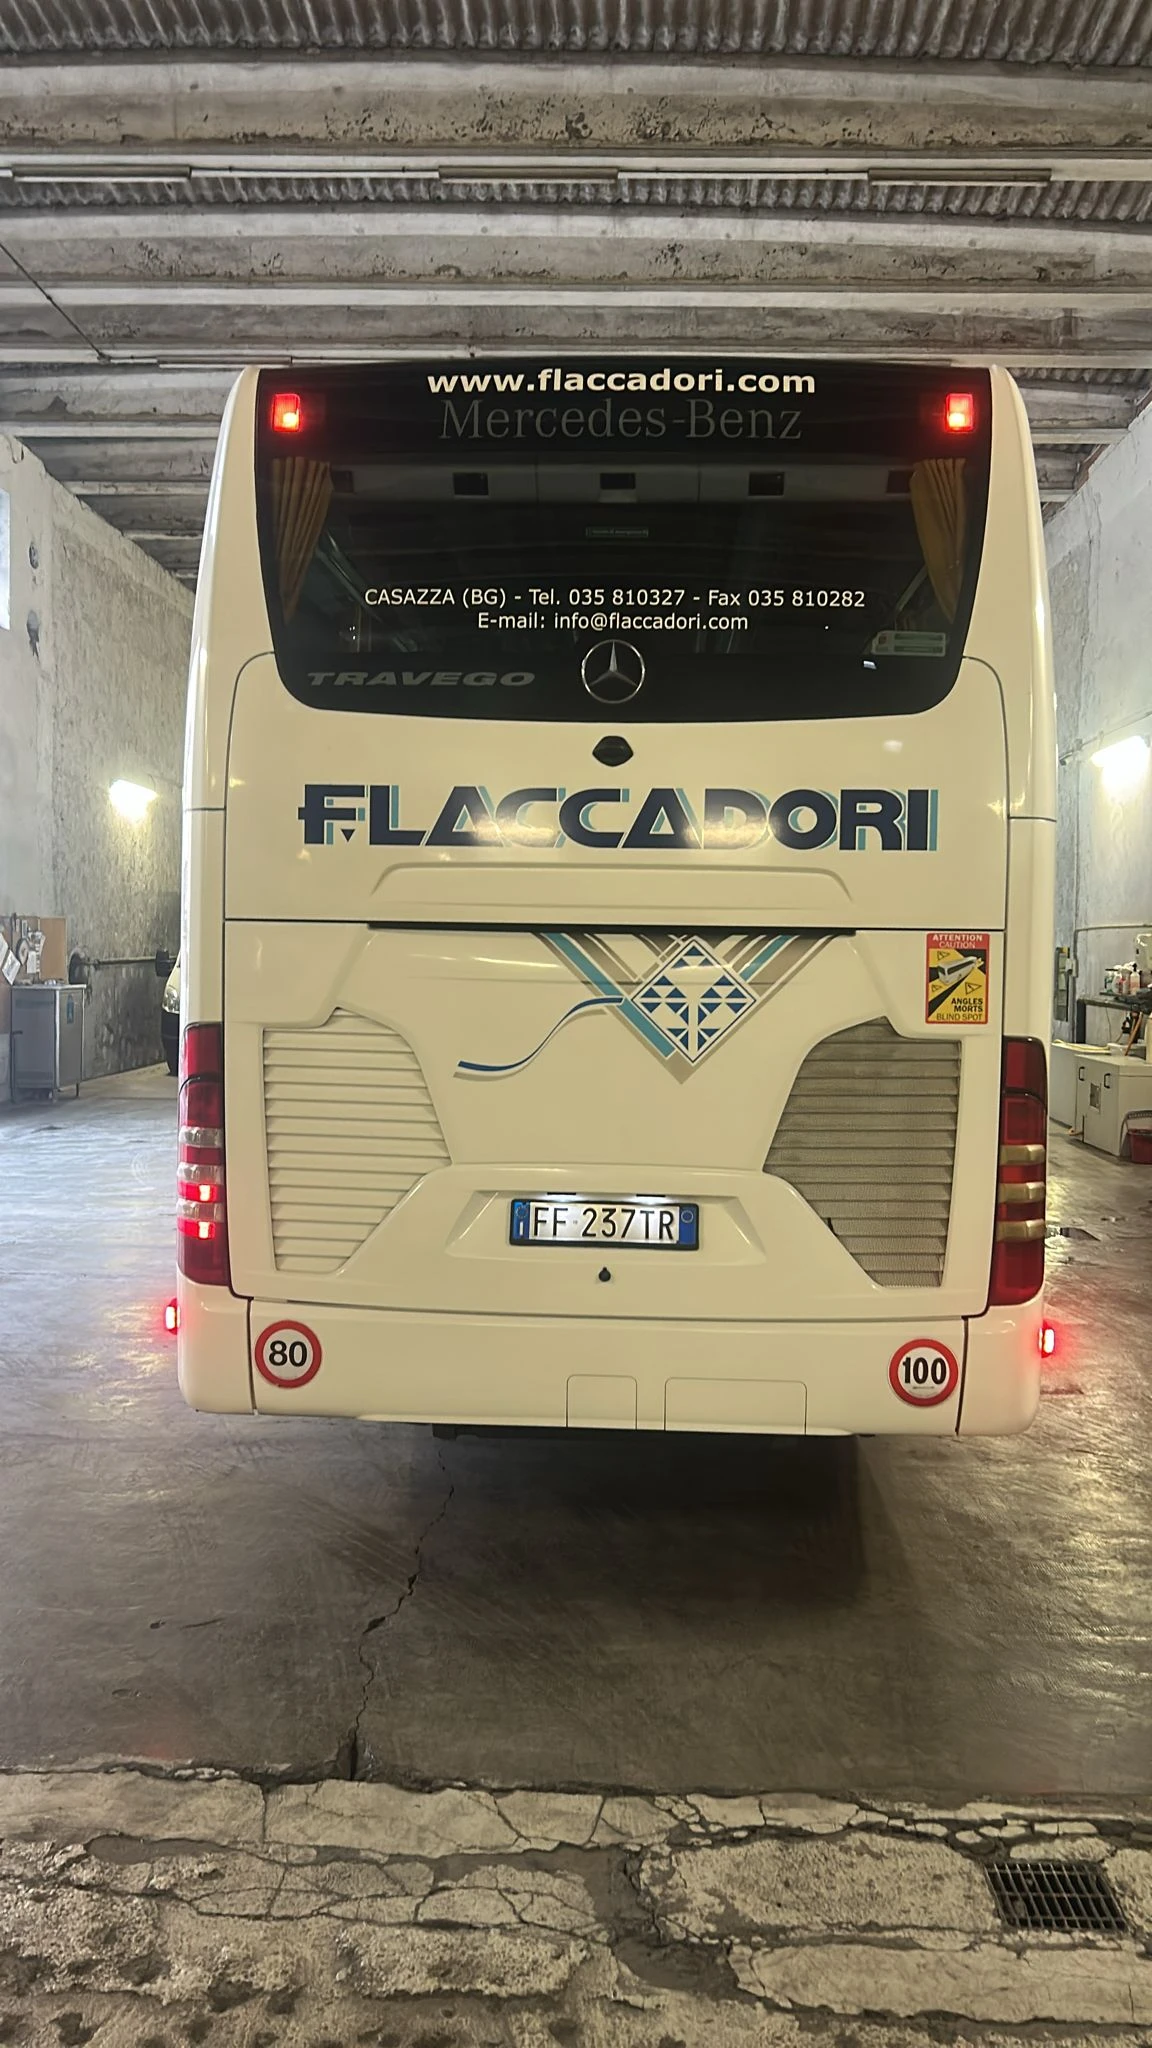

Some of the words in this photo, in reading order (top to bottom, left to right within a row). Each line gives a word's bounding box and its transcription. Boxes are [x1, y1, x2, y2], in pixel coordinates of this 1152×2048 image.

[426, 368, 816, 394] www.flaccadori.com
[439, 398, 803, 440] Mercedes-Benz
[364, 588, 455, 606] CASAZZA
[462, 588, 506, 608] (BG)
[529, 588, 560, 606] Tel.
[569, 588, 605, 606] 035
[612, 589, 685, 606] 810327
[708, 589, 741, 606] Fax
[748, 590, 784, 607] 035
[791, 590, 865, 608] 810282
[477, 612, 546, 629] E-mail:
[554, 612, 748, 631] info@flaccadori.com
[308, 671, 536, 687] TRAVEGO
[298, 784, 939, 852] FLACCADORI
[932, 933, 983, 941] ATTENTION
[939, 941, 976, 949] CAUTION
[936, 1013, 961, 1021] BLIND
[962, 1013, 982, 1021] SPOT
[953, 1005, 984, 1013] MORTS
[268, 1340, 308, 1367] 80
[902, 1357, 947, 1385] 100
